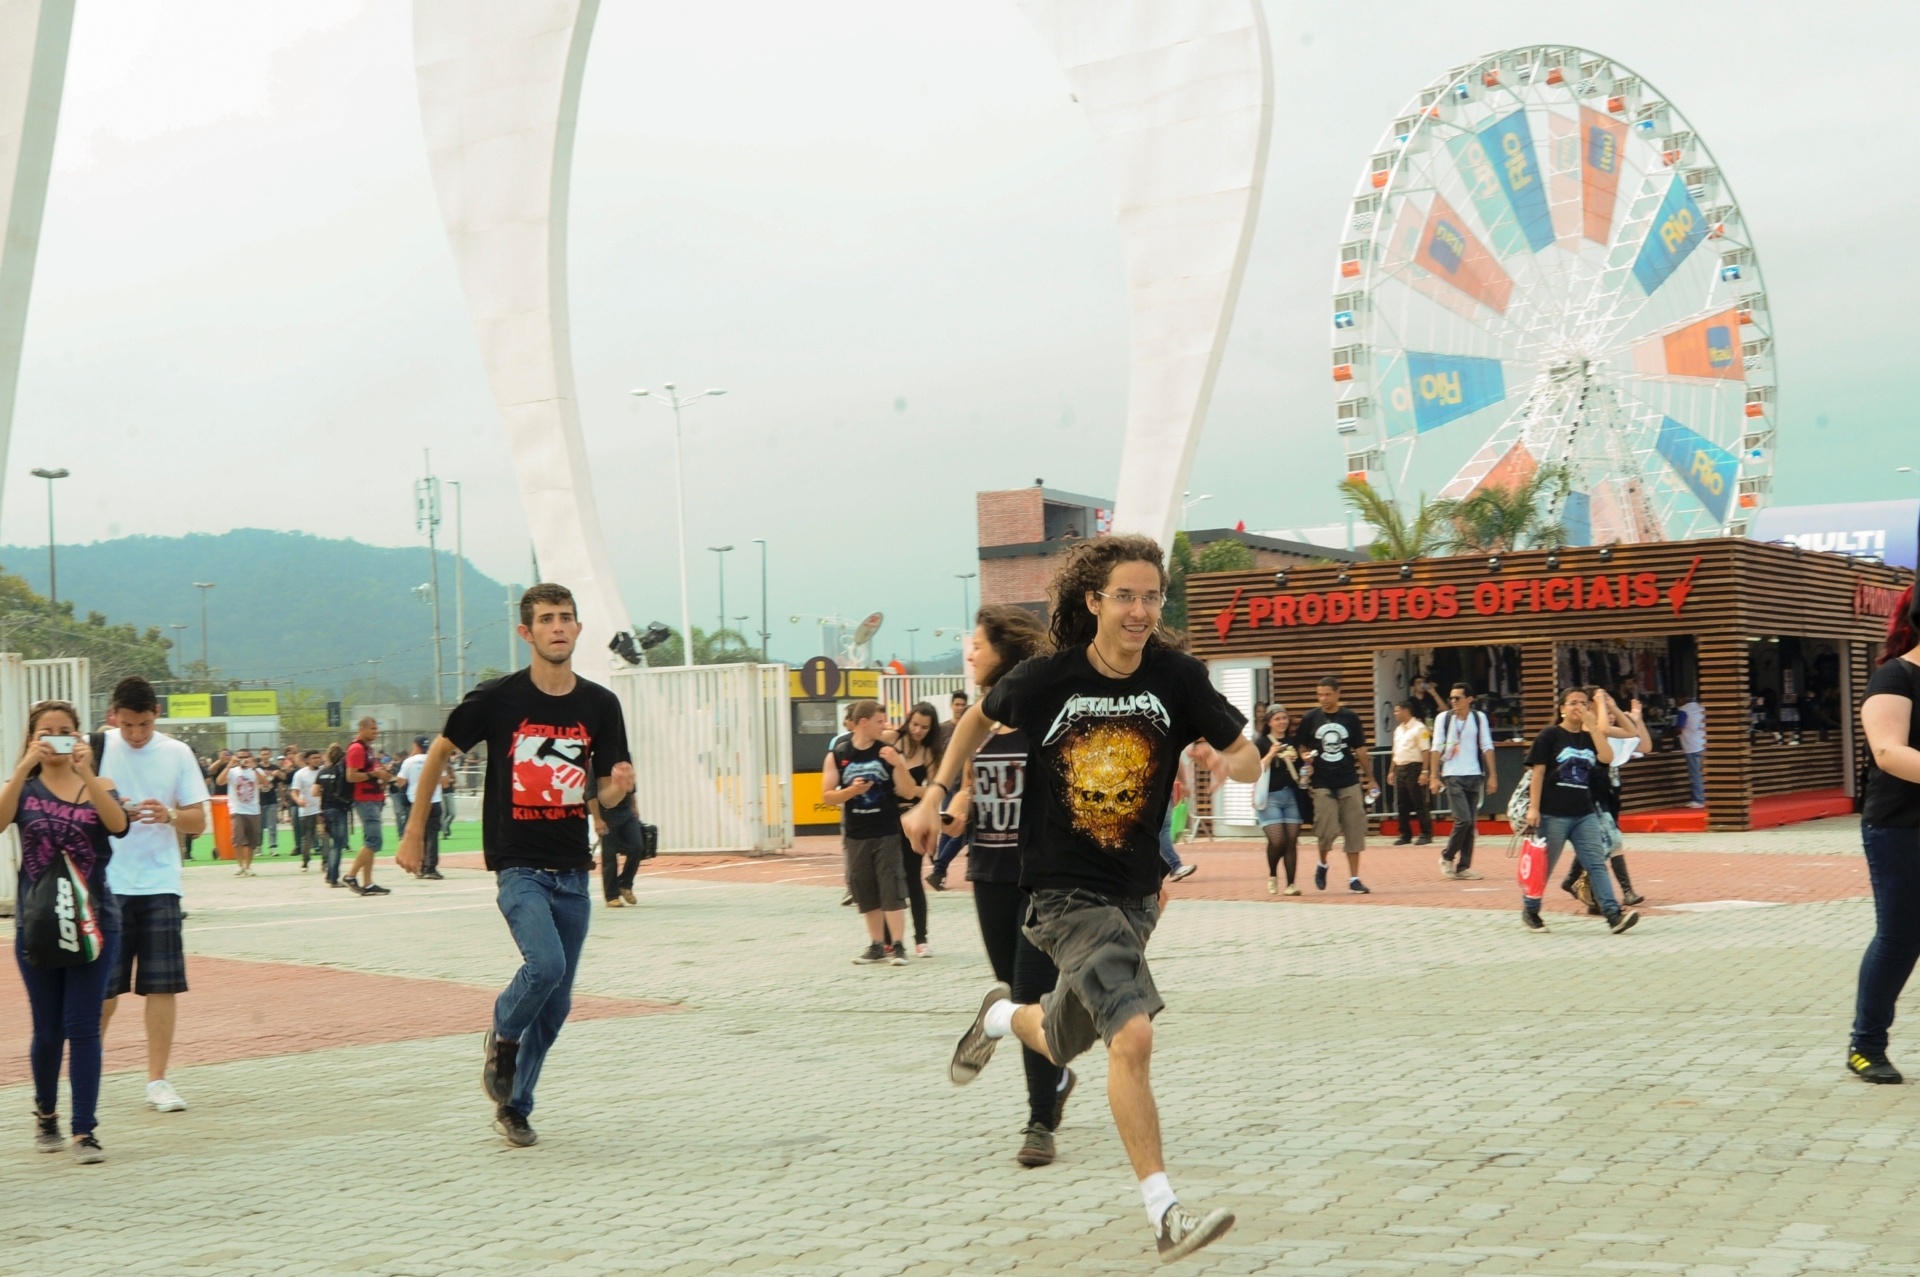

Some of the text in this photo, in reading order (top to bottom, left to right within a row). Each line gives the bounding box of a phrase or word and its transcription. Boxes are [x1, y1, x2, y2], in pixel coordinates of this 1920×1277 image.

[1249, 572, 1660, 628] PRODUTOS OFICIAIS
[509, 718, 592, 754] METALLICA
[1042, 691, 1171, 746] METALLICA
[54, 877, 80, 952] lotto
